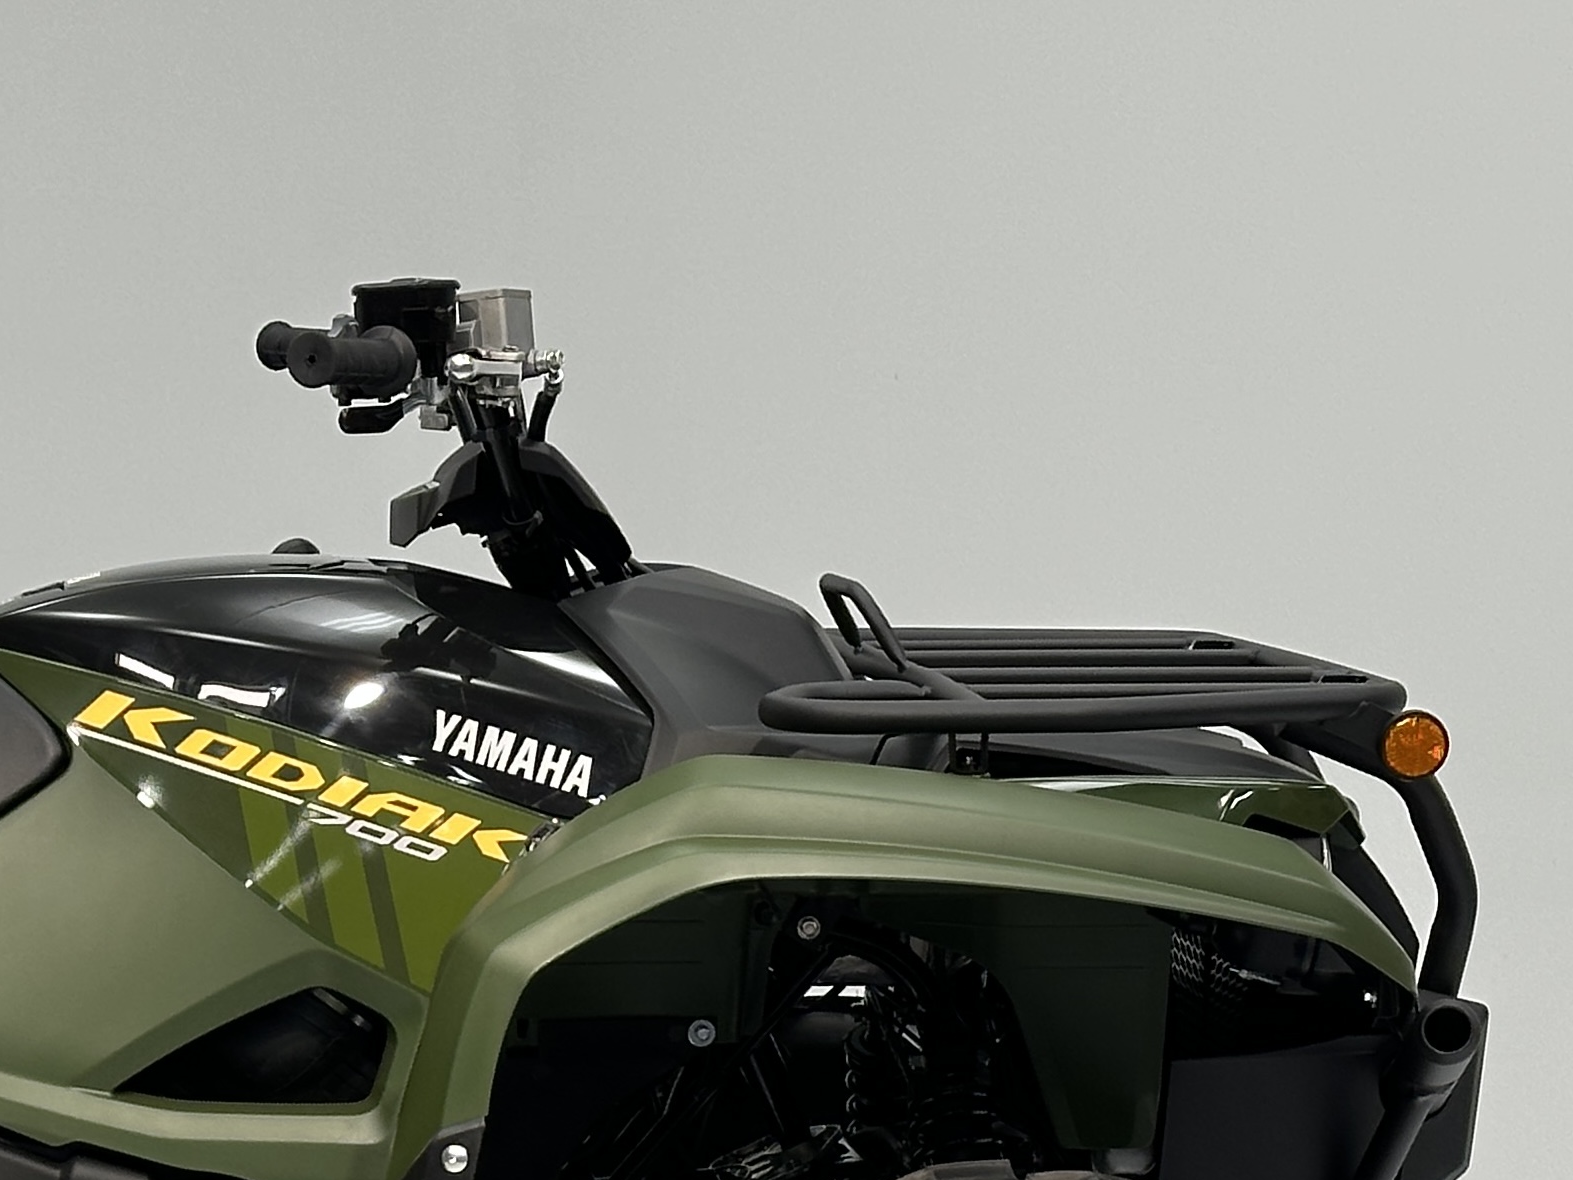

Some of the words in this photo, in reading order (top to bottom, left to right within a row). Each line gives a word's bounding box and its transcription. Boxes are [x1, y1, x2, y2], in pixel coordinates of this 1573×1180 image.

[74, 688, 529, 864] KODIAK
[431, 708, 594, 799] YAMAHA
[305, 802, 448, 862] 700
